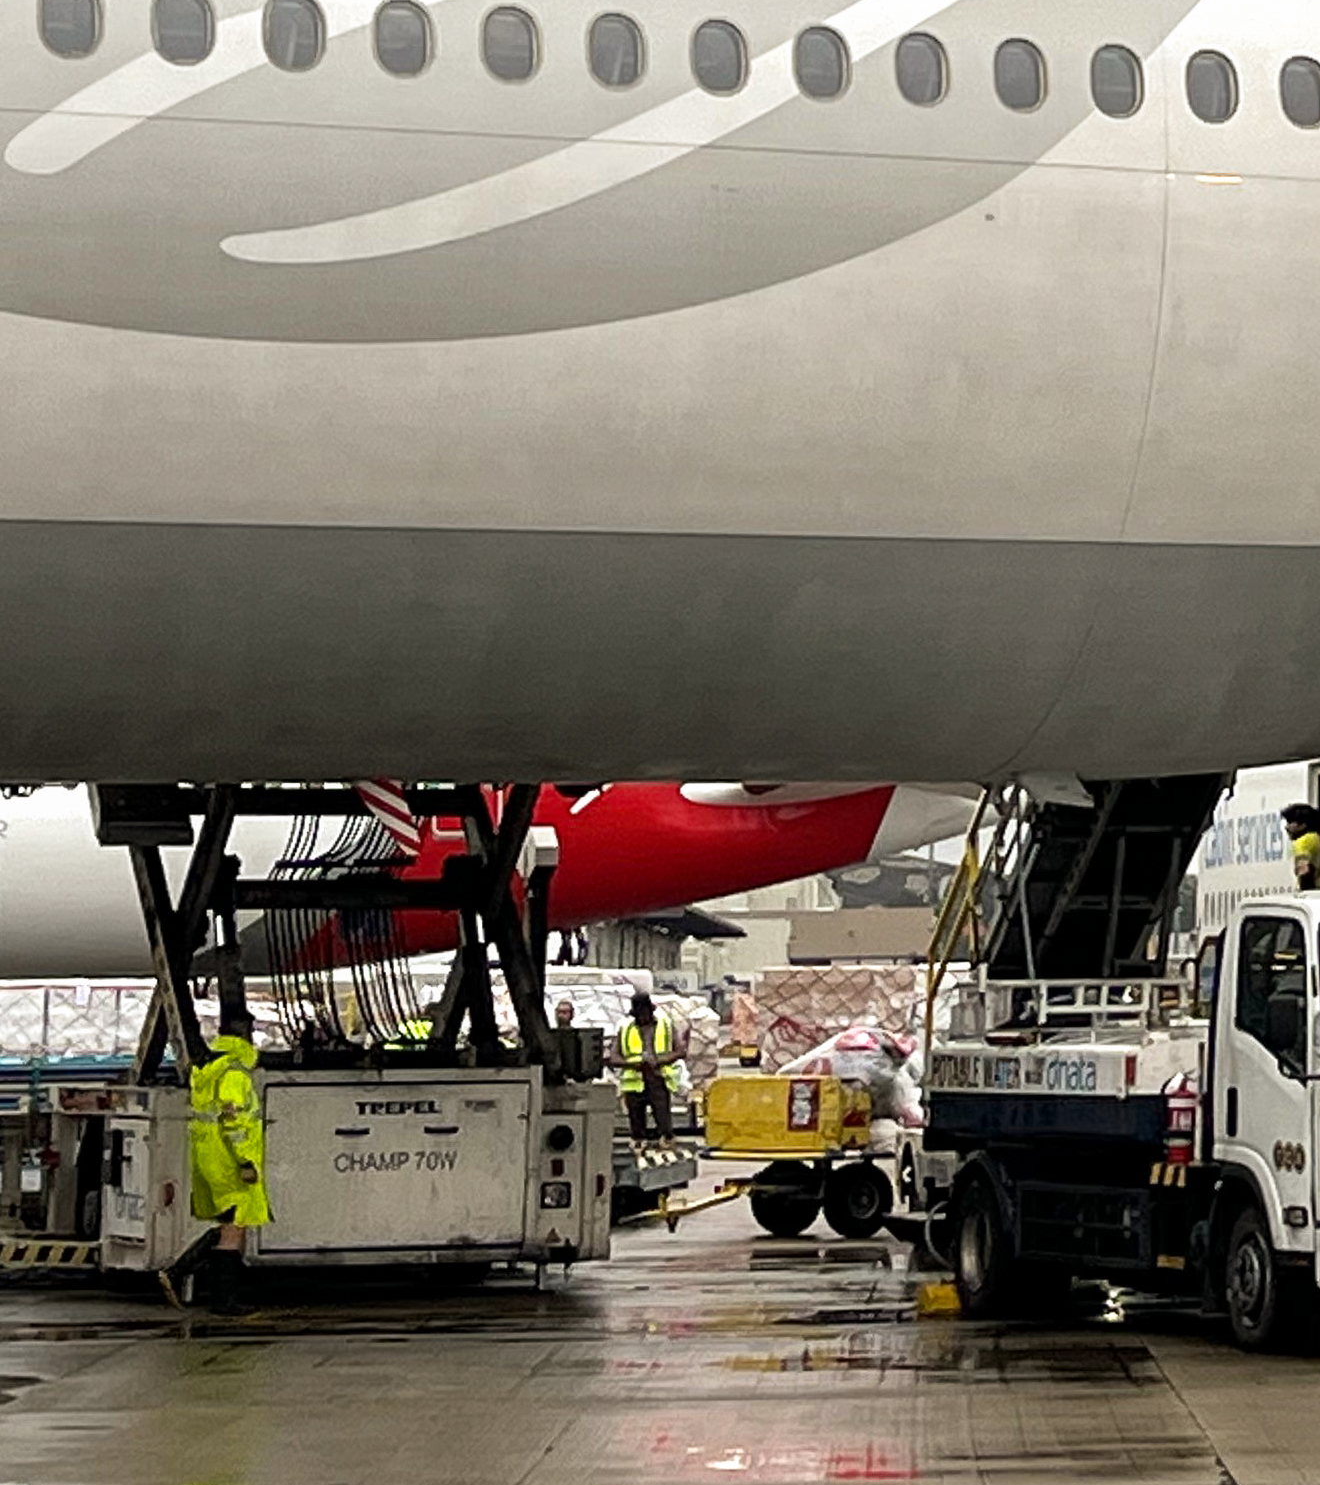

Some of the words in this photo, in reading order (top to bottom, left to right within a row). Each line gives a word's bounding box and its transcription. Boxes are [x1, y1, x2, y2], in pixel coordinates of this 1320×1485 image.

[1048, 1051, 1097, 1091] dnata
[355, 1100, 441, 1115] TREPEL
[333, 1150, 409, 1173] CHAMP
[415, 1150, 458, 1172] 70W
